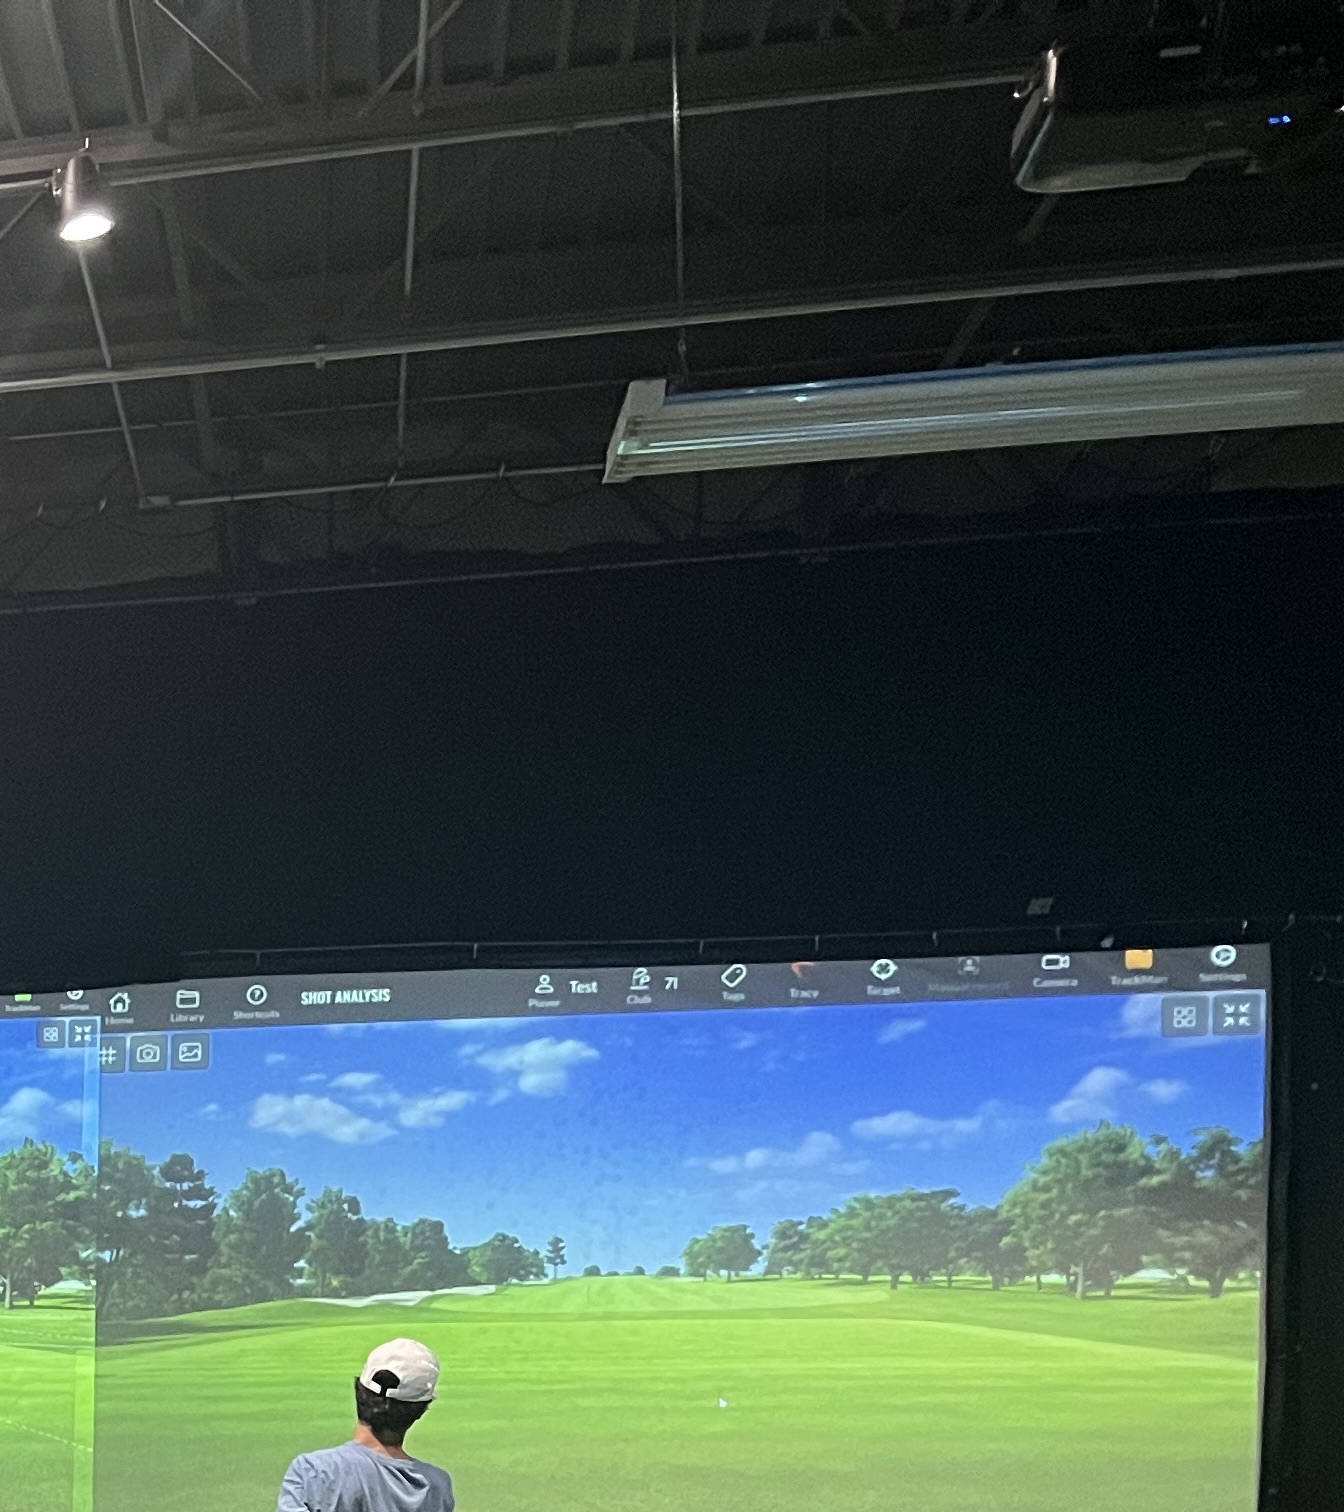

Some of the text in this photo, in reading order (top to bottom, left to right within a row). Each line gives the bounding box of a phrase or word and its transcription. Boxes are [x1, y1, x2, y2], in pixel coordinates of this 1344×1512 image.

[570, 980, 597, 993] Test
[301, 988, 390, 1005] SHOT ANALYSIS
